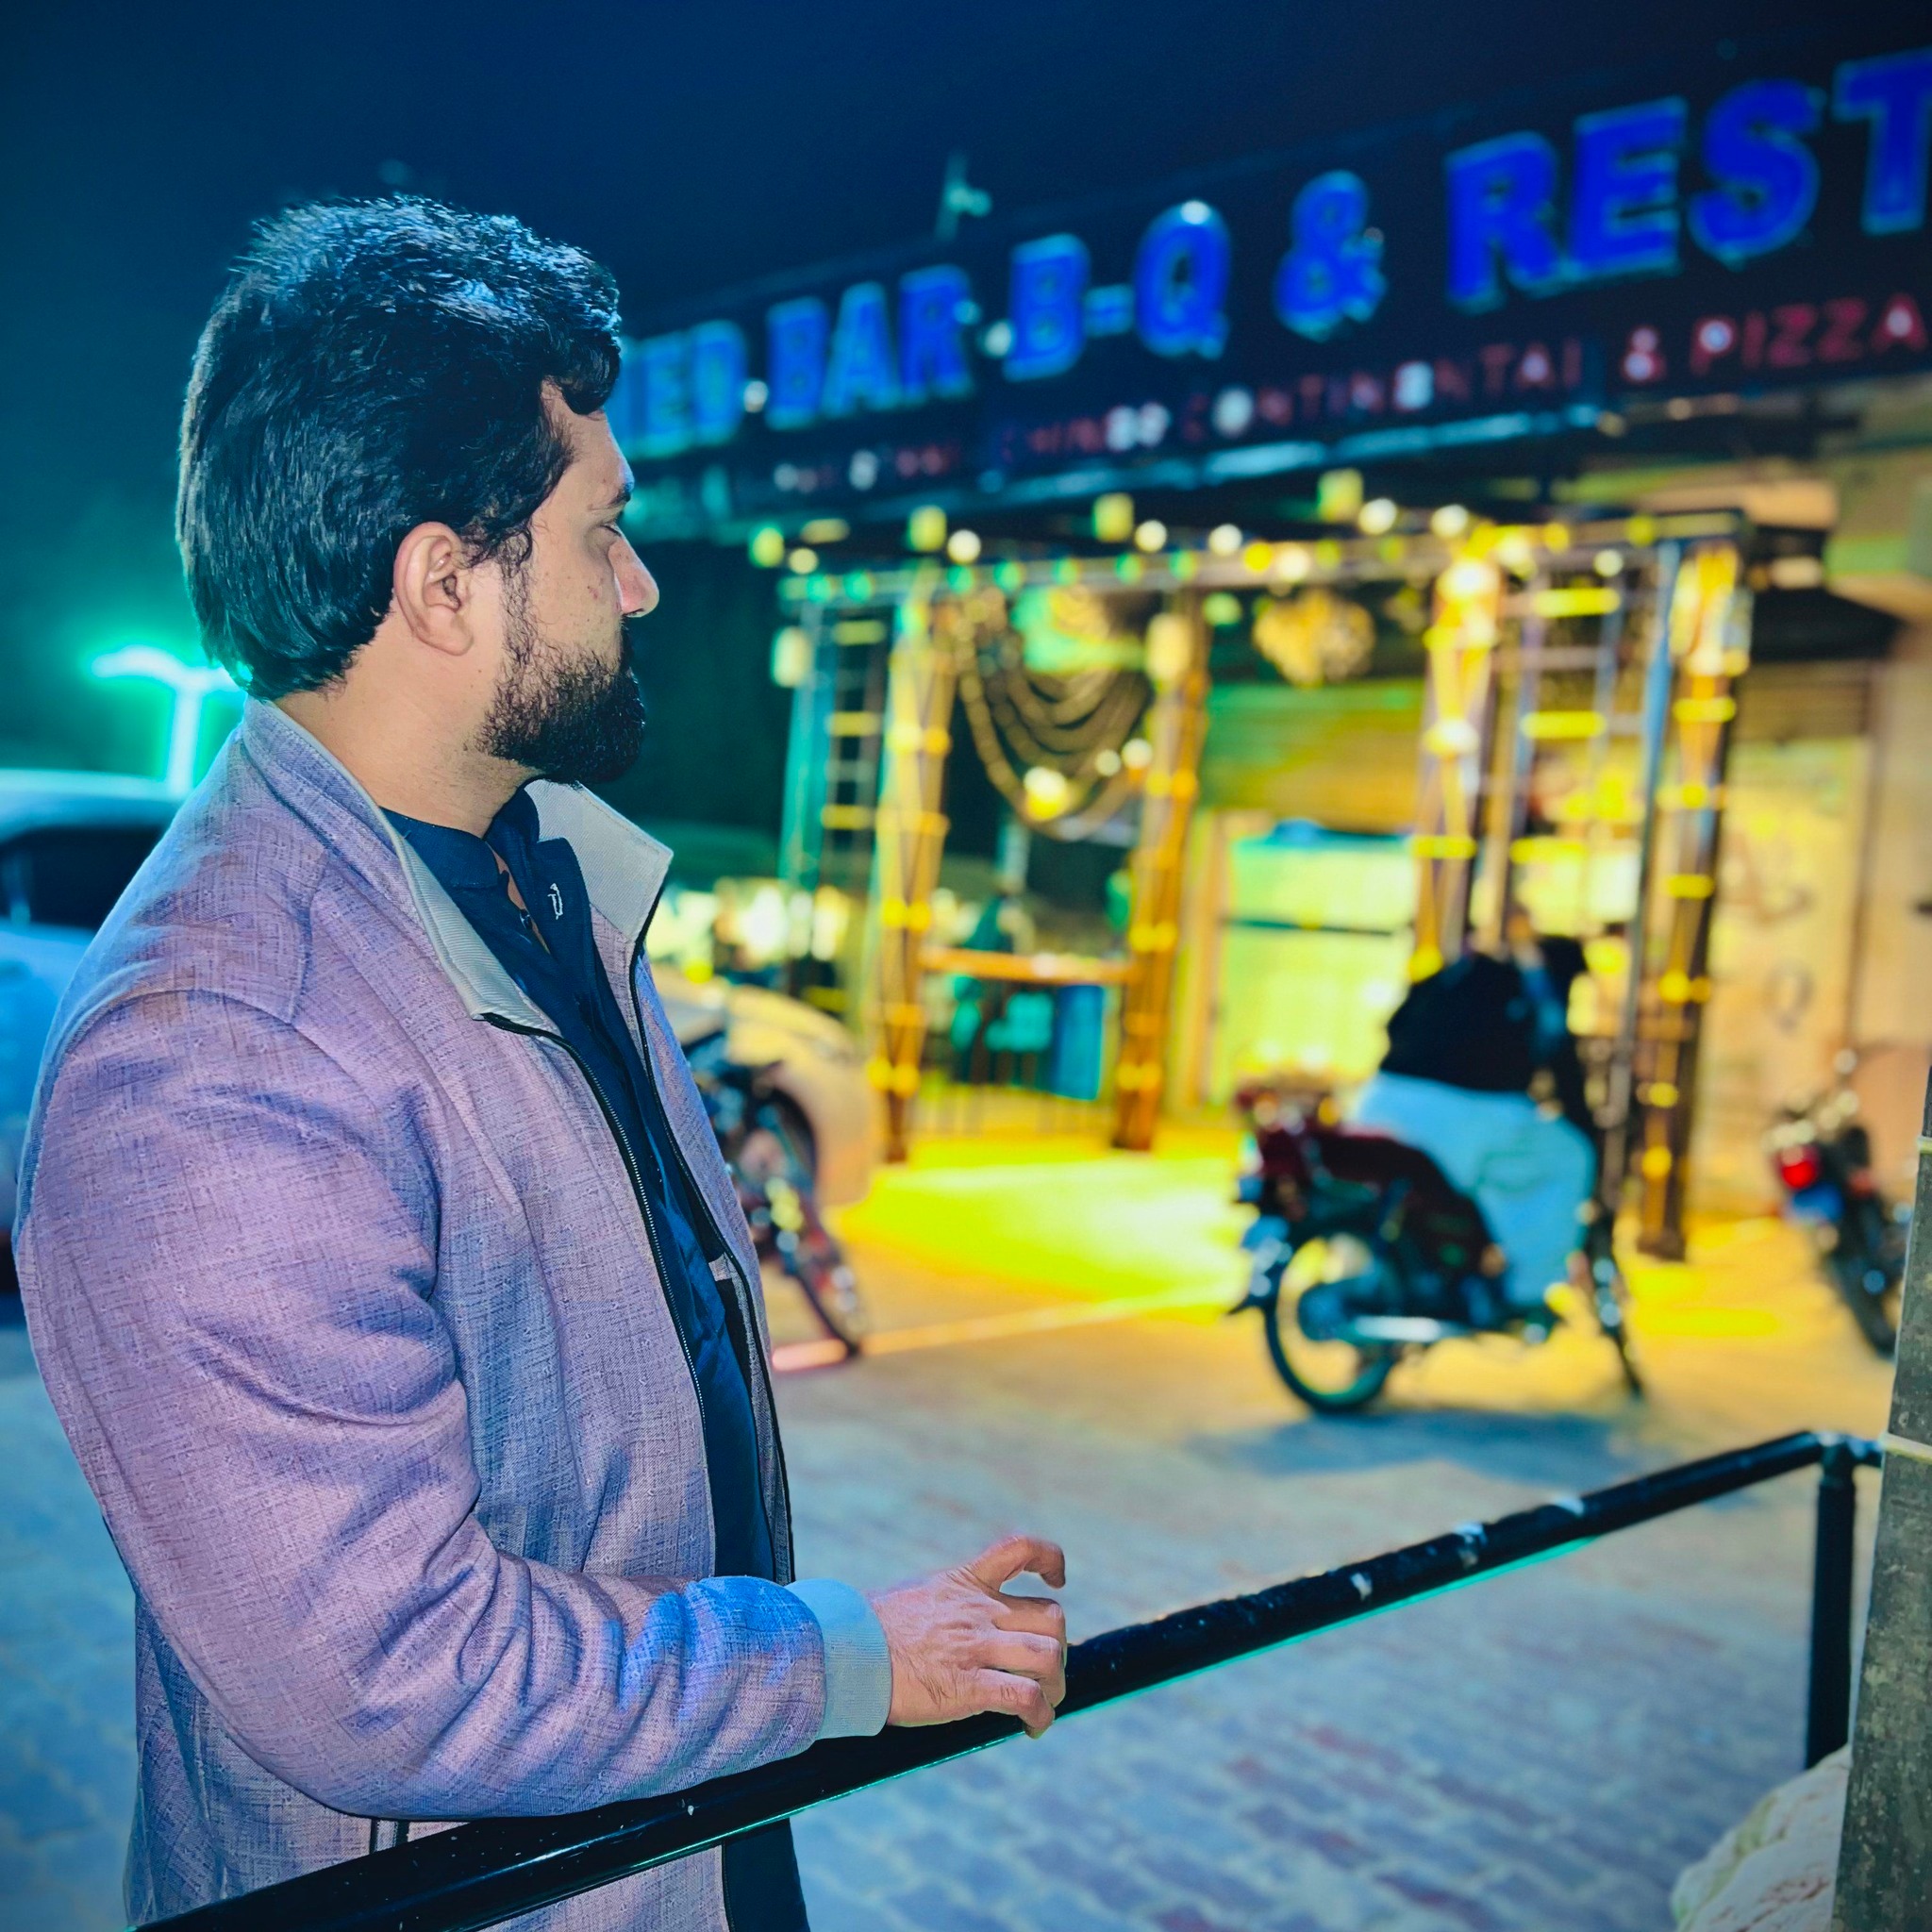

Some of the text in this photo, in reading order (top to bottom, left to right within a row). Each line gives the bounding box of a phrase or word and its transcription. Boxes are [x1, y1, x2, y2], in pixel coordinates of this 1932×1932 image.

[766, 264, 974, 431] BAR
[1272, 170, 1387, 343] &
[1444, 47, 1932, 316] REST
[1690, 292, 1929, 375] PIZZA
